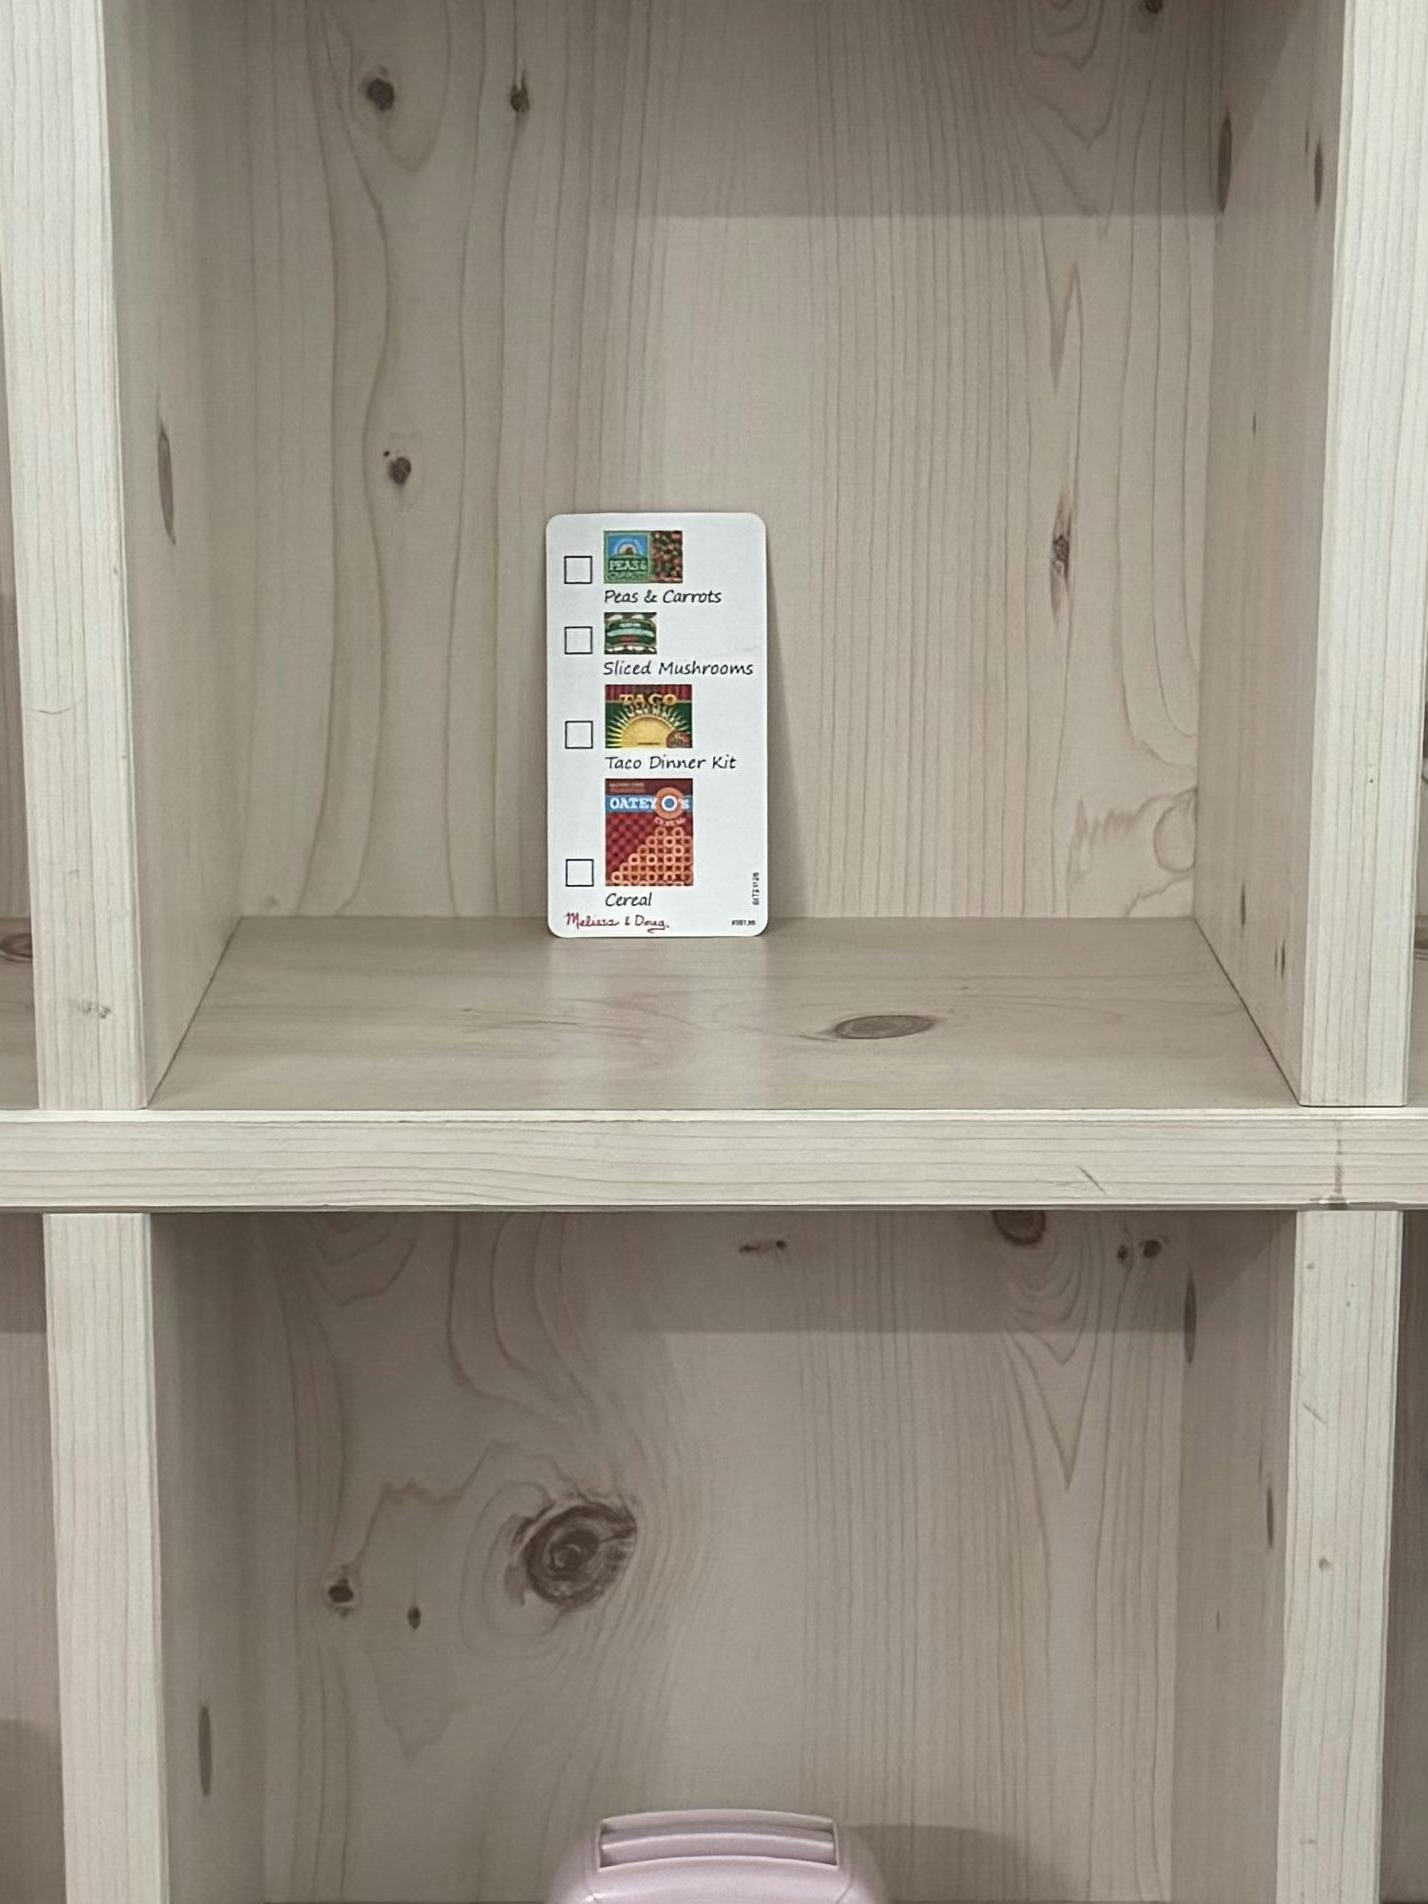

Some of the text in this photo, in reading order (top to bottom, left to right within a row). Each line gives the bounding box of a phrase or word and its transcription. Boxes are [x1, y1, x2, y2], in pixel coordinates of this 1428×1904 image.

[604, 589, 722, 603] Peas & Carrots
[603, 660, 754, 675] Sliced Mushrooms
[605, 754, 737, 770] Taco Dinner Kit
[605, 892, 652, 907] Cereal
[565, 912, 619, 929] Melissa
